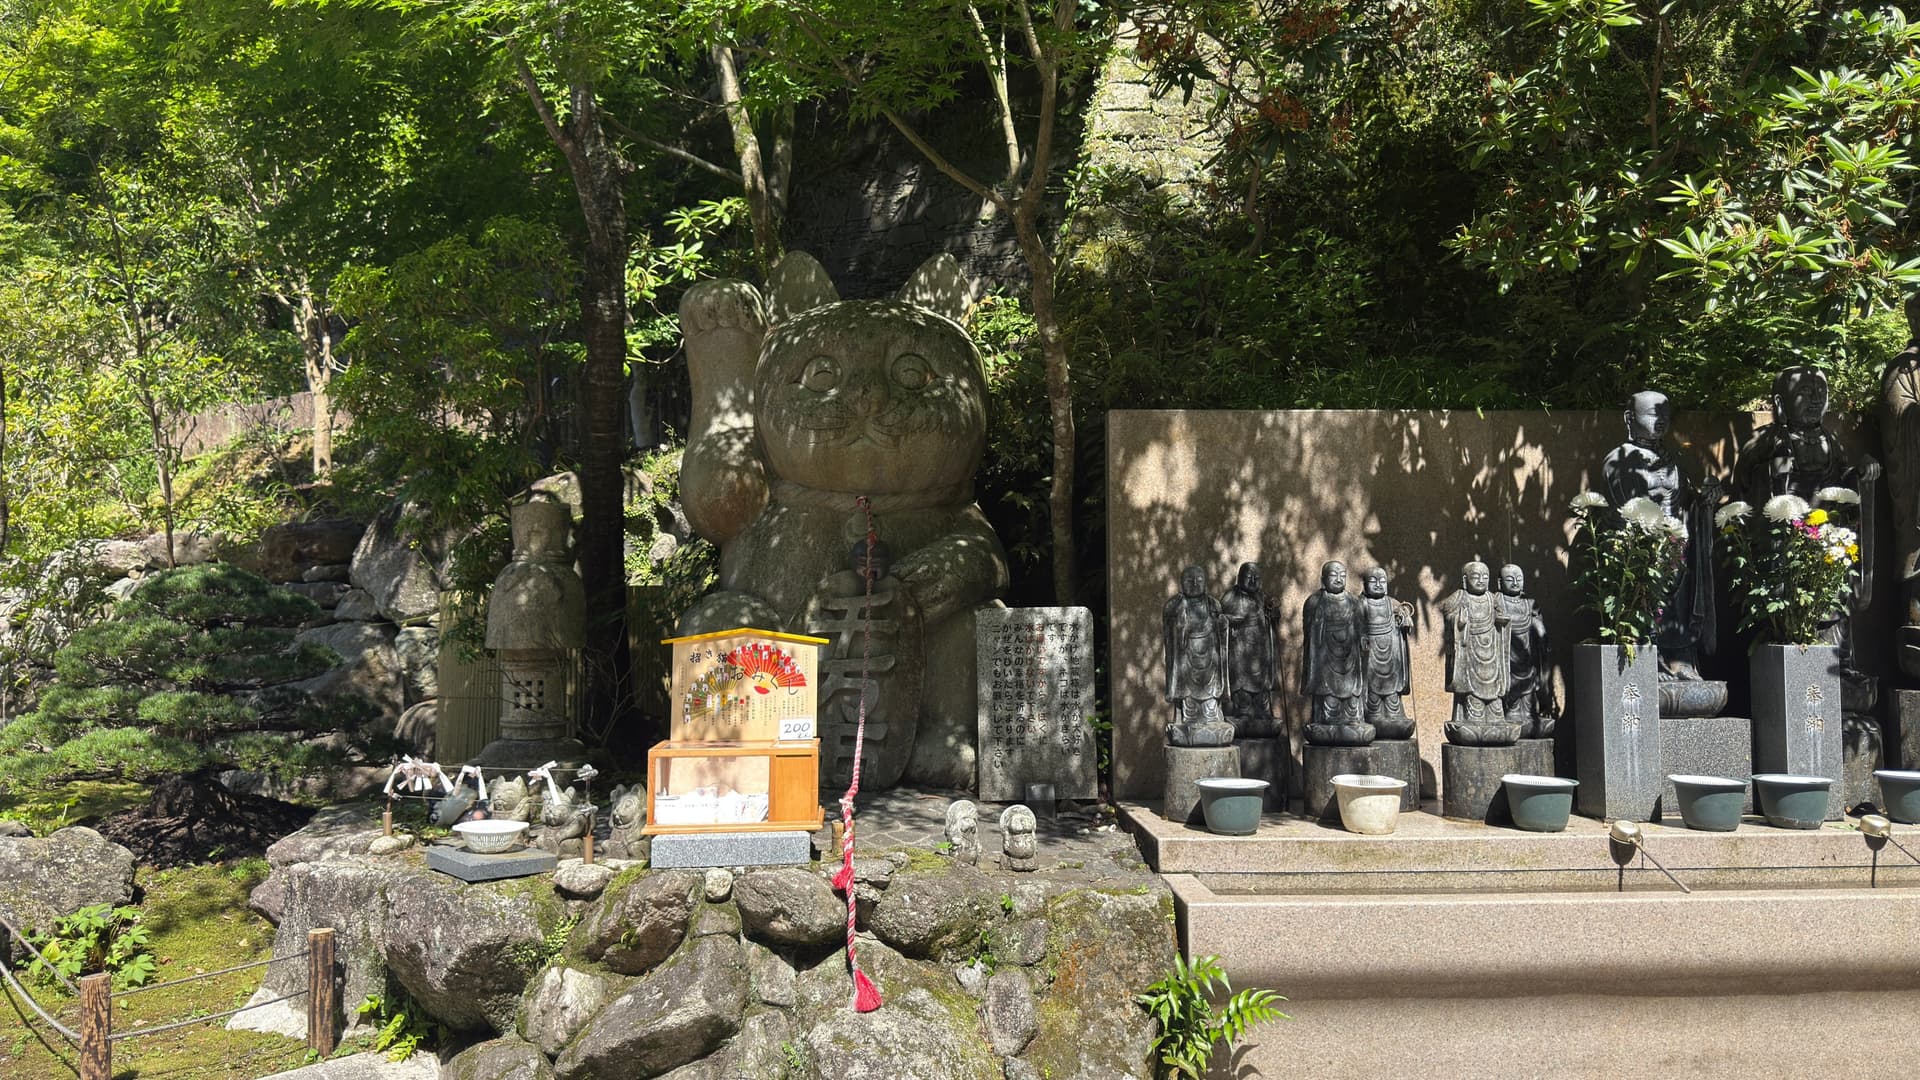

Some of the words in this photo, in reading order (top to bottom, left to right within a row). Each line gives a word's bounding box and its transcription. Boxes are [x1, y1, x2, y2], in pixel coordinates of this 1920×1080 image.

[689, 649, 728, 663] 招き猫
[1622, 683, 1641, 731] 奉納
[1805, 684, 1825, 732] 奉納
[783, 722, 811, 734] 200
